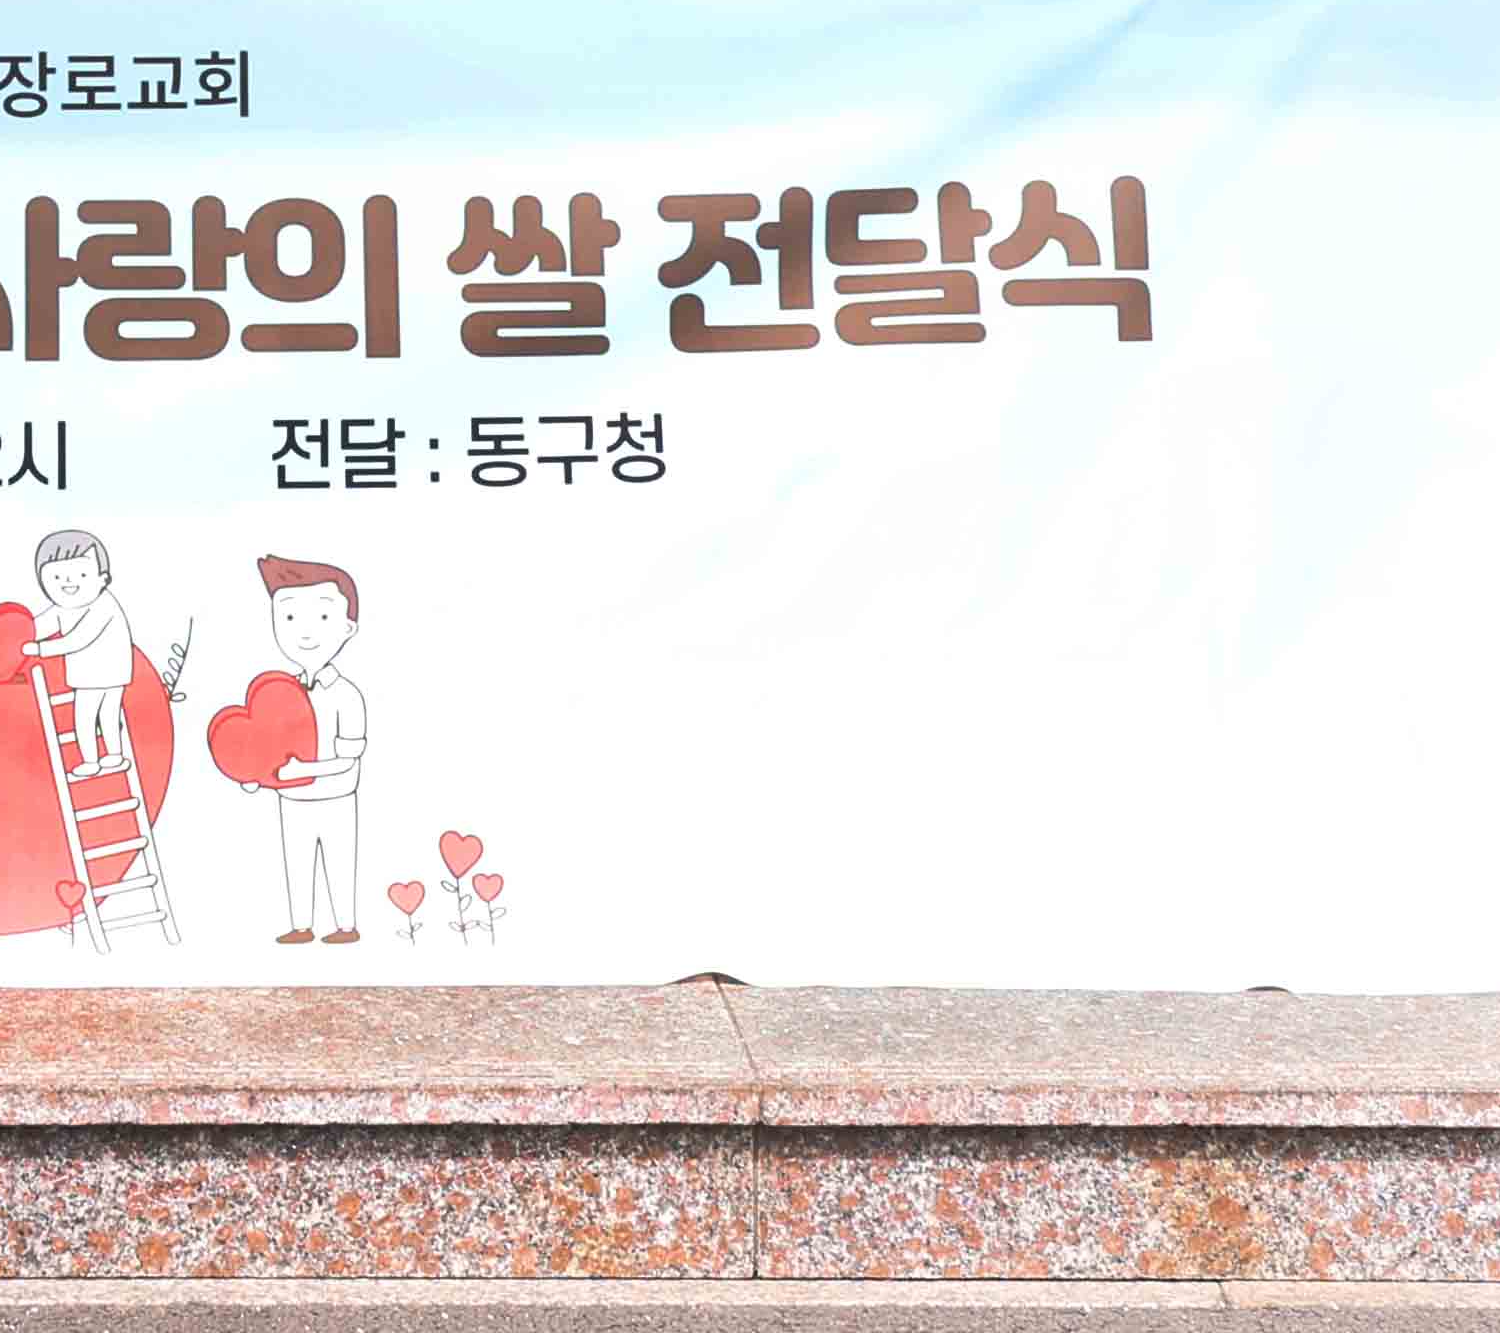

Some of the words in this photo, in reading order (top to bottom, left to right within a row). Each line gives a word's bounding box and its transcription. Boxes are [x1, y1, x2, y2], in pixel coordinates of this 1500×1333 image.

[447, 192, 621, 357] 쌀
[657, 176, 1153, 353] 전달식
[272, 418, 406, 489] 전달
[467, 412, 666, 487] 동구청
